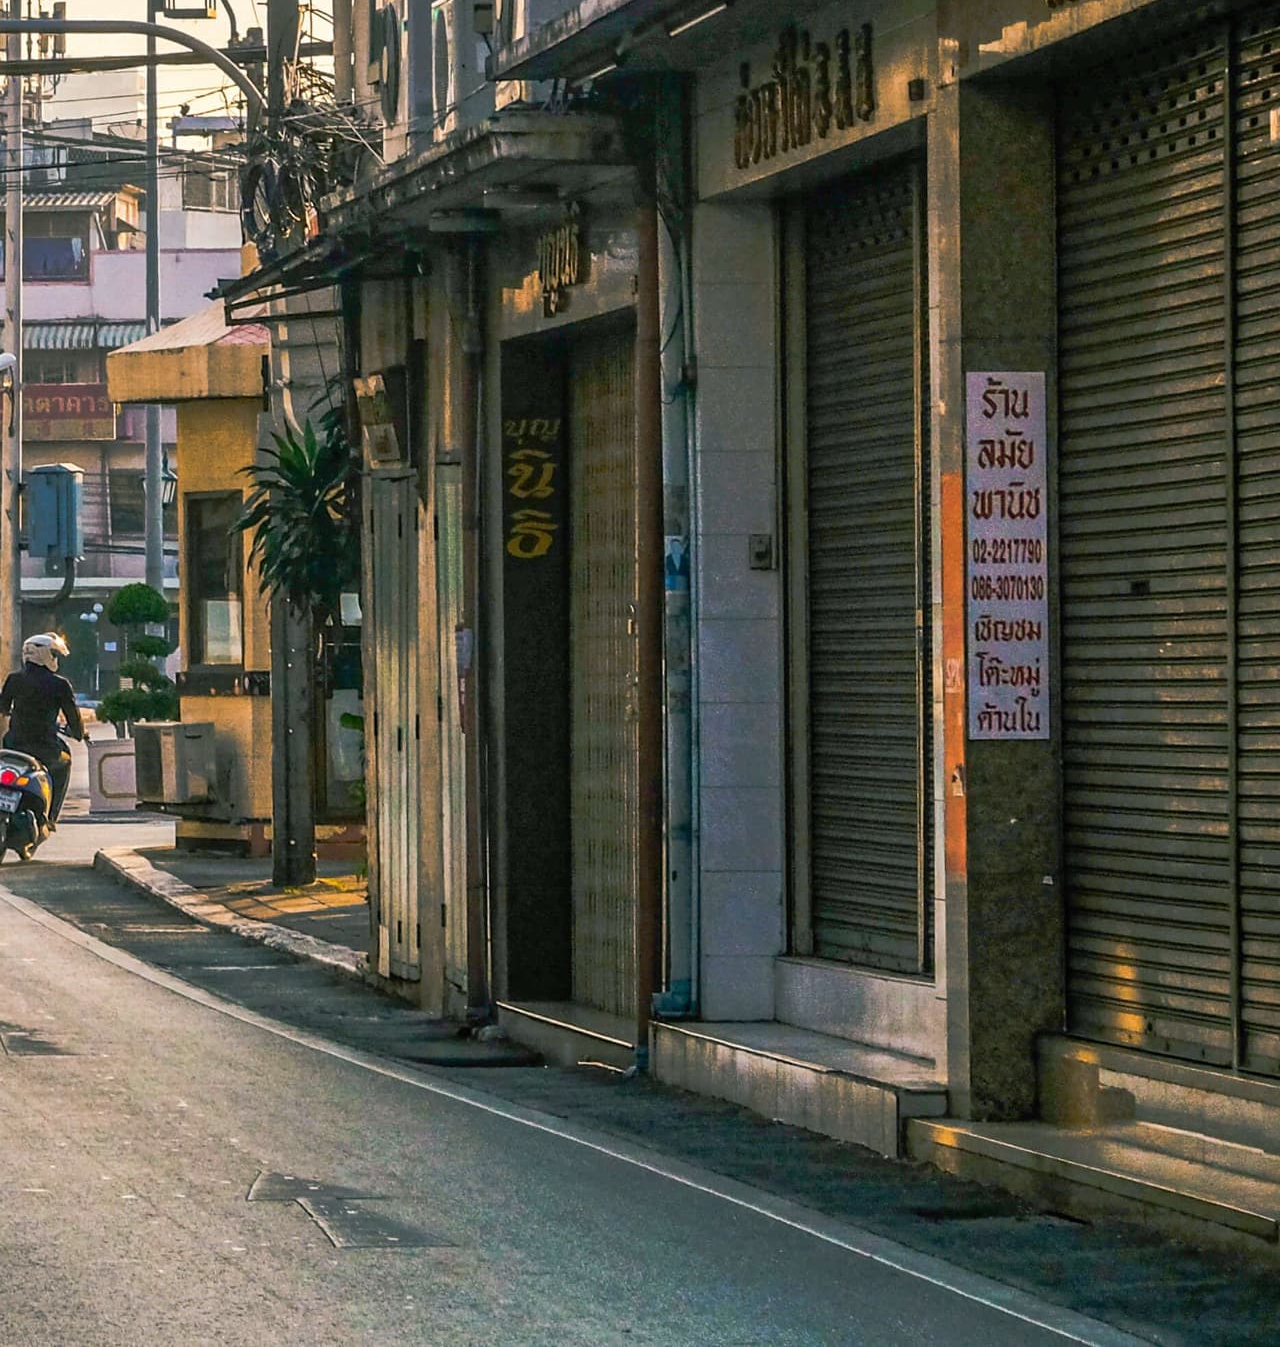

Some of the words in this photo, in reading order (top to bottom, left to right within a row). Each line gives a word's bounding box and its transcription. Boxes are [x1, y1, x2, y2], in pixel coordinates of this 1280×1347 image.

[982, 377, 1030, 420] ร้าน
[972, 482, 1041, 521] พานิช
[972, 538, 1042, 564] 02-2217790
[971, 575, 1044, 601] 086-3070130
[974, 614, 1042, 642] เชิญชม
[976, 651, 1041, 697] โต๊ะหมู่
